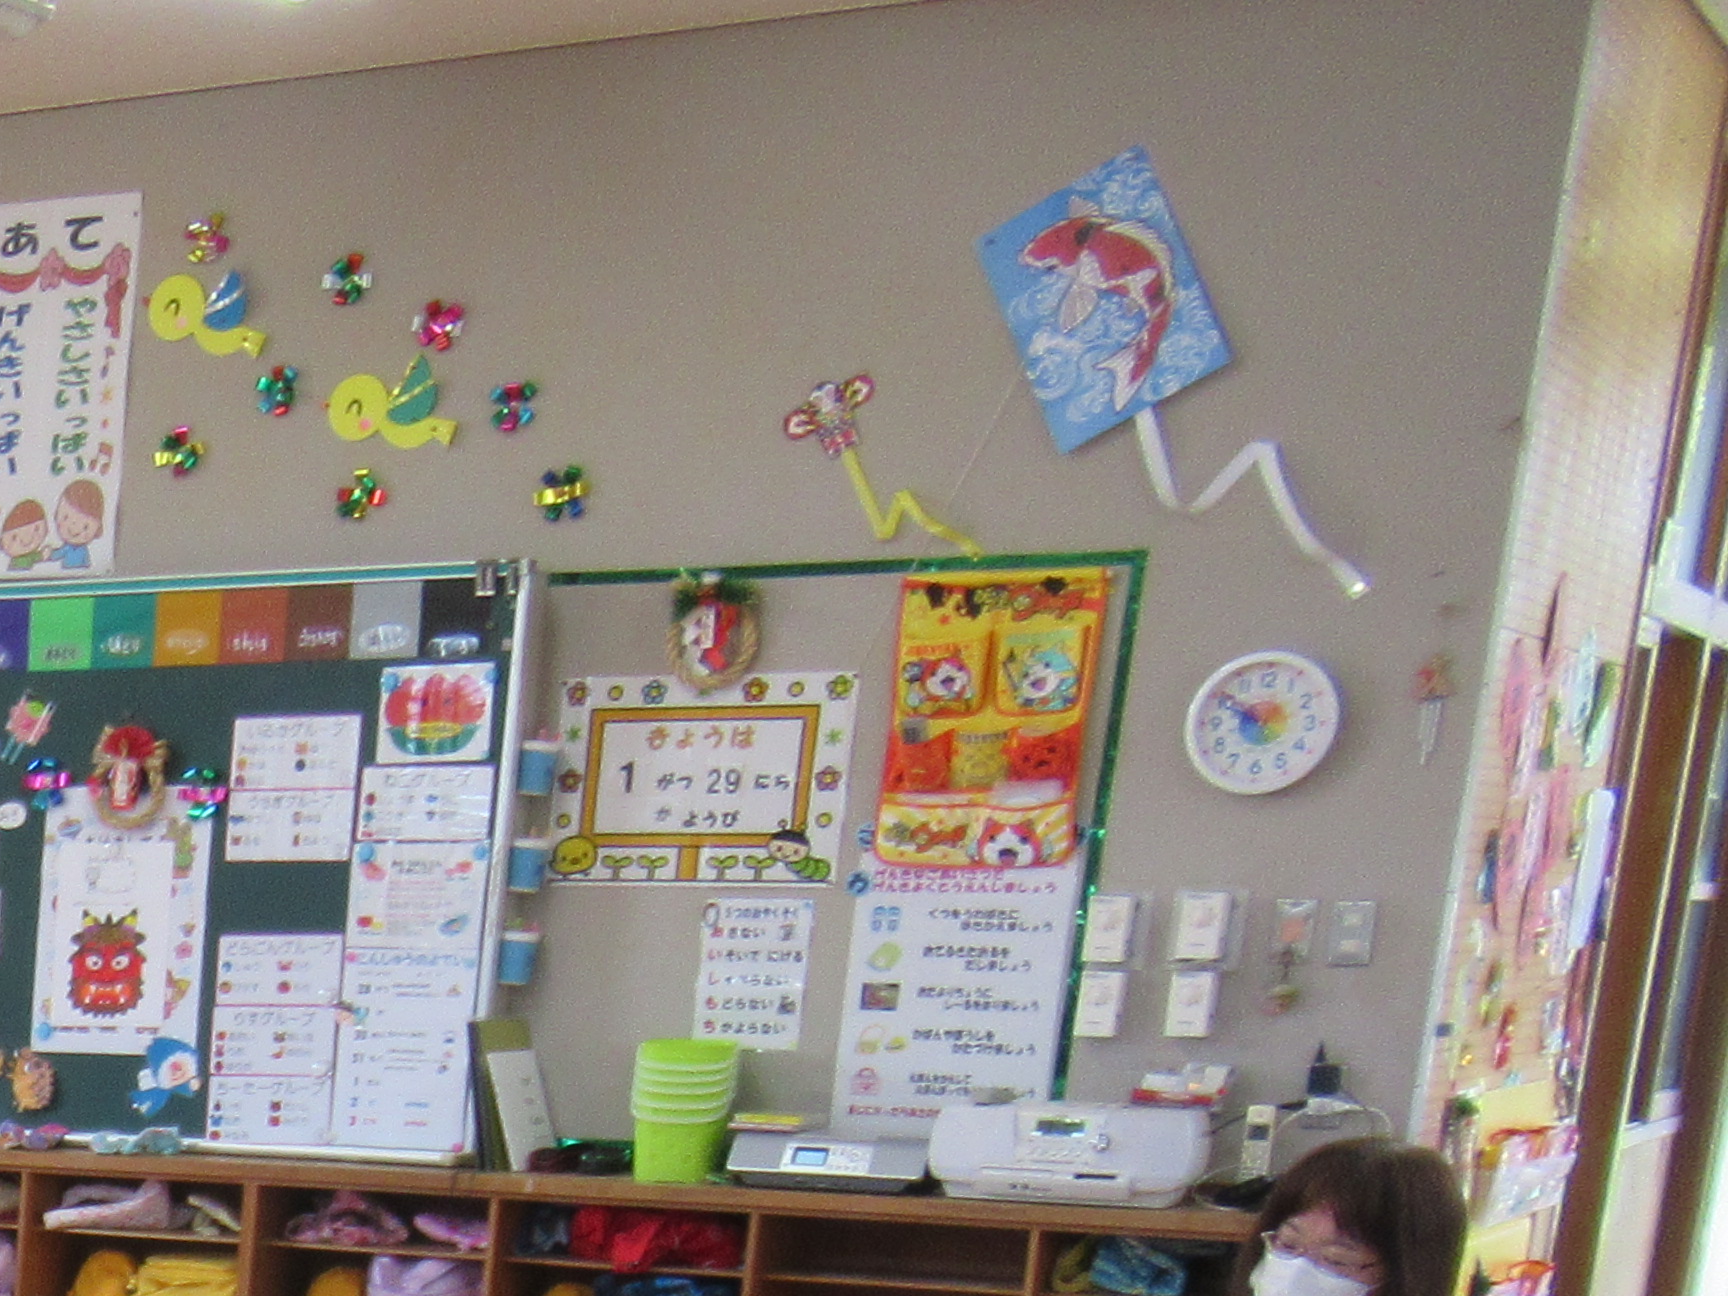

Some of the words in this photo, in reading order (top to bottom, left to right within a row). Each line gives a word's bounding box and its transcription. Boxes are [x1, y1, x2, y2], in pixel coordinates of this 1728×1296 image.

[51, 297, 99, 476] やさしさいっぱい
[1261, 671, 1276, 688] 12
[1300, 693, 1313, 709] 2
[1210, 715, 1222, 730] 9
[1303, 715, 1316, 731] 3
[645, 725, 756, 750] きょうは
[1214, 737, 1225, 753] 8
[1293, 736, 1306, 750] 4
[1226, 753, 1240, 768] 7
[1249, 760, 1262, 774] 6
[1275, 752, 1287, 769] 5
[620, 761, 635, 793] 1
[657, 772, 693, 791] がつ
[706, 768, 741, 794] 29
[753, 774, 791, 791] にち
